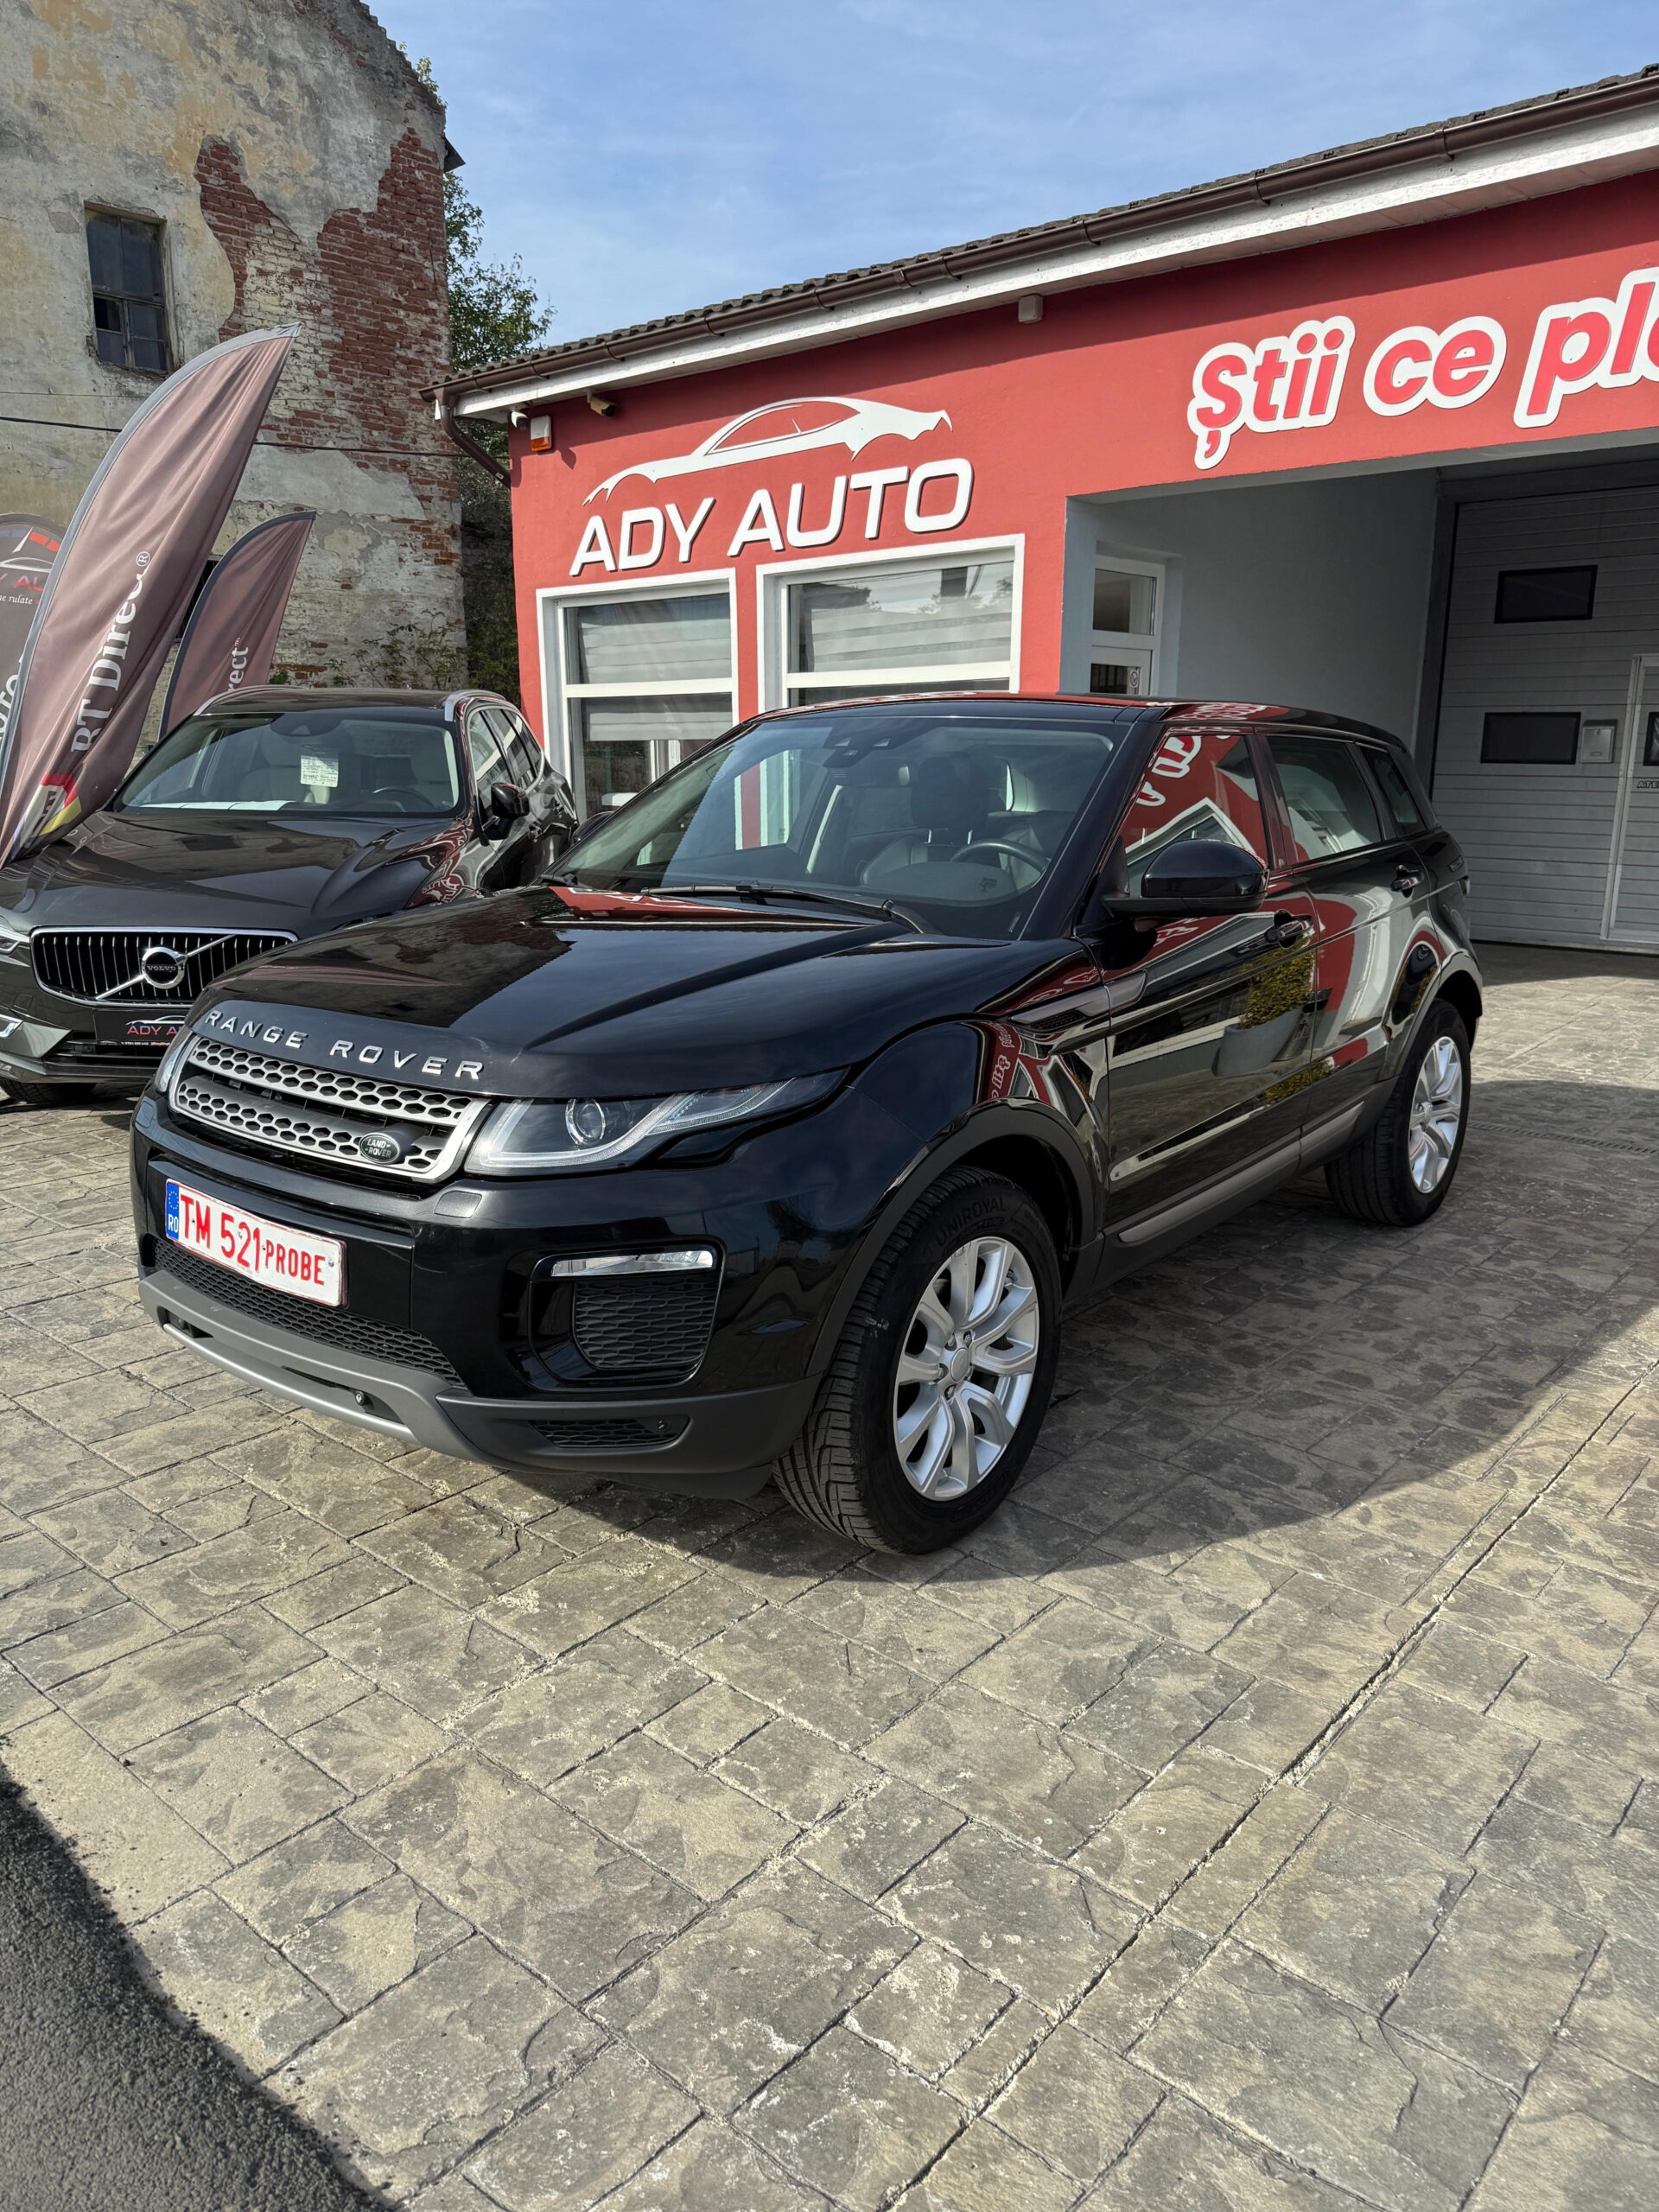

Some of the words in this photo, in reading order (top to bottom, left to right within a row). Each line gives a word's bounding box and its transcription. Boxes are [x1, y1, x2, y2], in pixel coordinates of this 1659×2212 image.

[1367, 319, 1503, 413] ce
[569, 497, 716, 576] ADY
[727, 458, 973, 556] AUTO
[126, 1026, 162, 1035] ADY
[205, 1009, 308, 1048] RANGE
[329, 1039, 483, 1080] ROVER
[367, 1138, 386, 1148] LAND
[368, 1147, 392, 1158] ROVER
[168, 1214, 179, 1233] RO
[181, 1194, 211, 1249] TM
[220, 1212, 261, 1272] 521
[265, 1239, 326, 1286] PROBE
